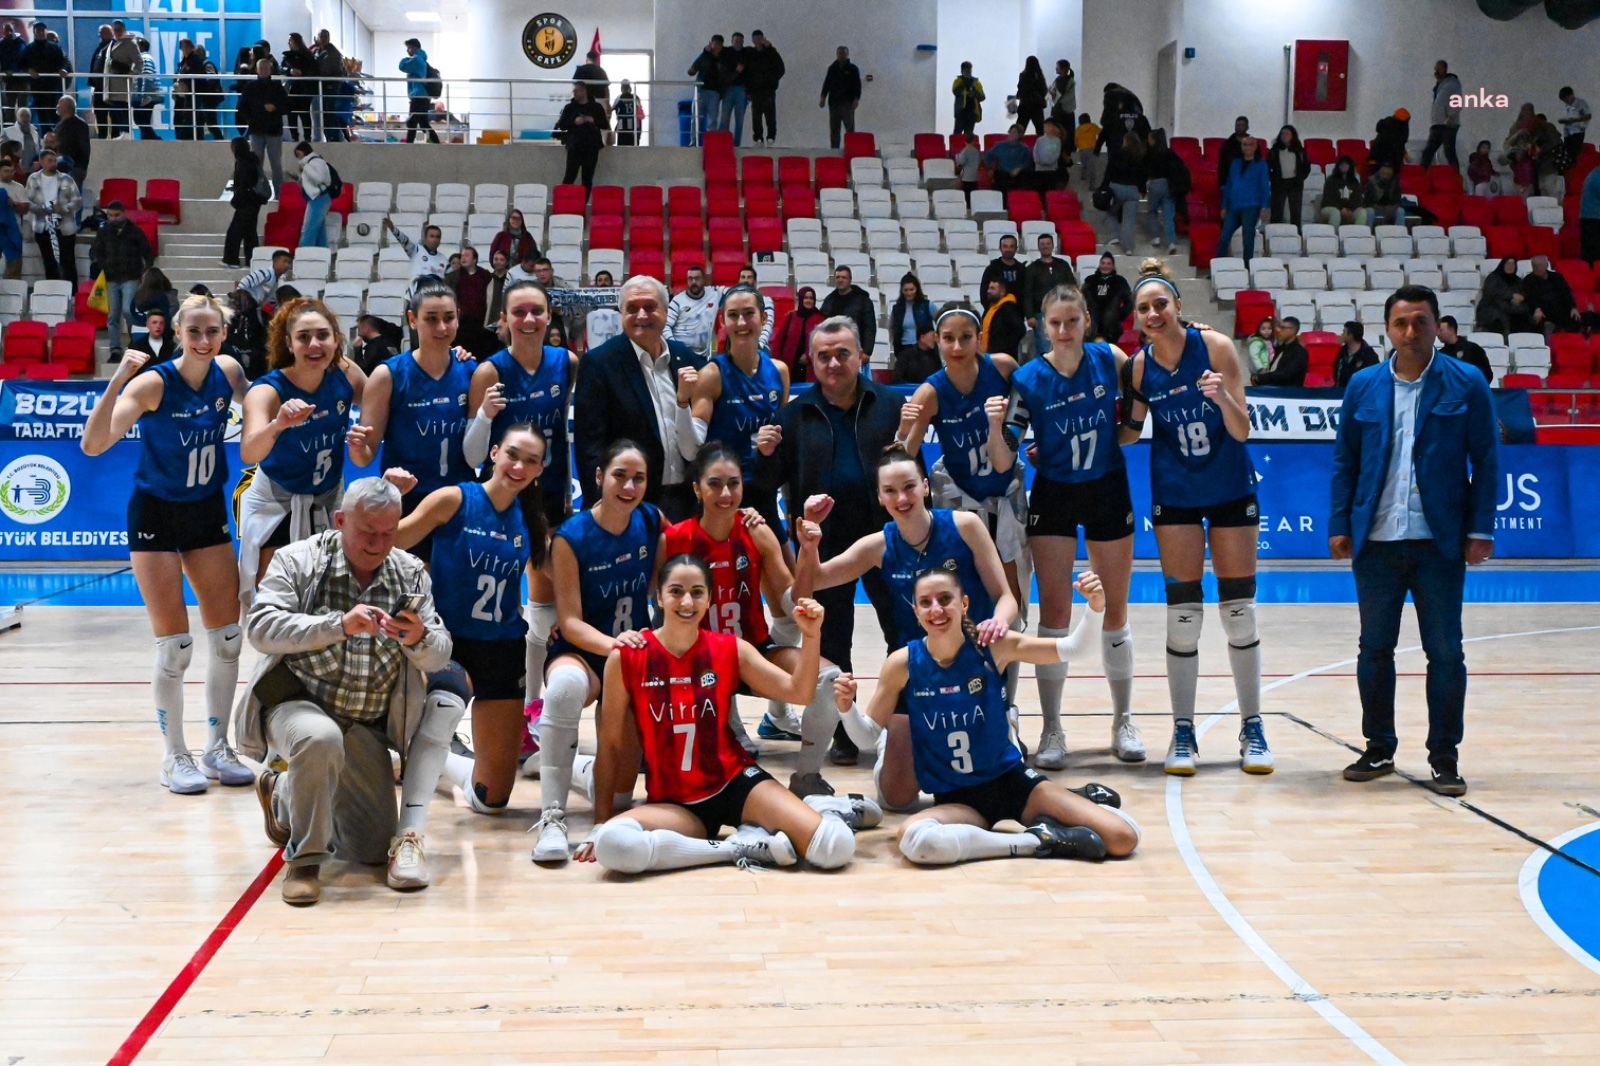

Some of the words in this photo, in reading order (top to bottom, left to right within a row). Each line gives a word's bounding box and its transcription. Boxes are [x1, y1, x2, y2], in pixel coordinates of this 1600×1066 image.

[536, 17, 563, 27] SPOR
[537, 55, 562, 65] CAFE
[1055, 409, 1107, 435] VitrA
[1177, 421, 1211, 457] 18
[186, 444, 216, 488] 10
[312, 448, 333, 486] 5
[439, 437, 449, 477] 1
[1070, 429, 1098, 471] 17
[1030, 514, 1040, 526] 17
[469, 548, 520, 576] VitrA
[612, 596, 633, 637] 8
[708, 601, 743, 638] 13
[649, 698, 717, 722] VitrA
[923, 705, 986, 730] VitrA
[673, 723, 697, 771] 7
[947, 730, 973, 774] 3
